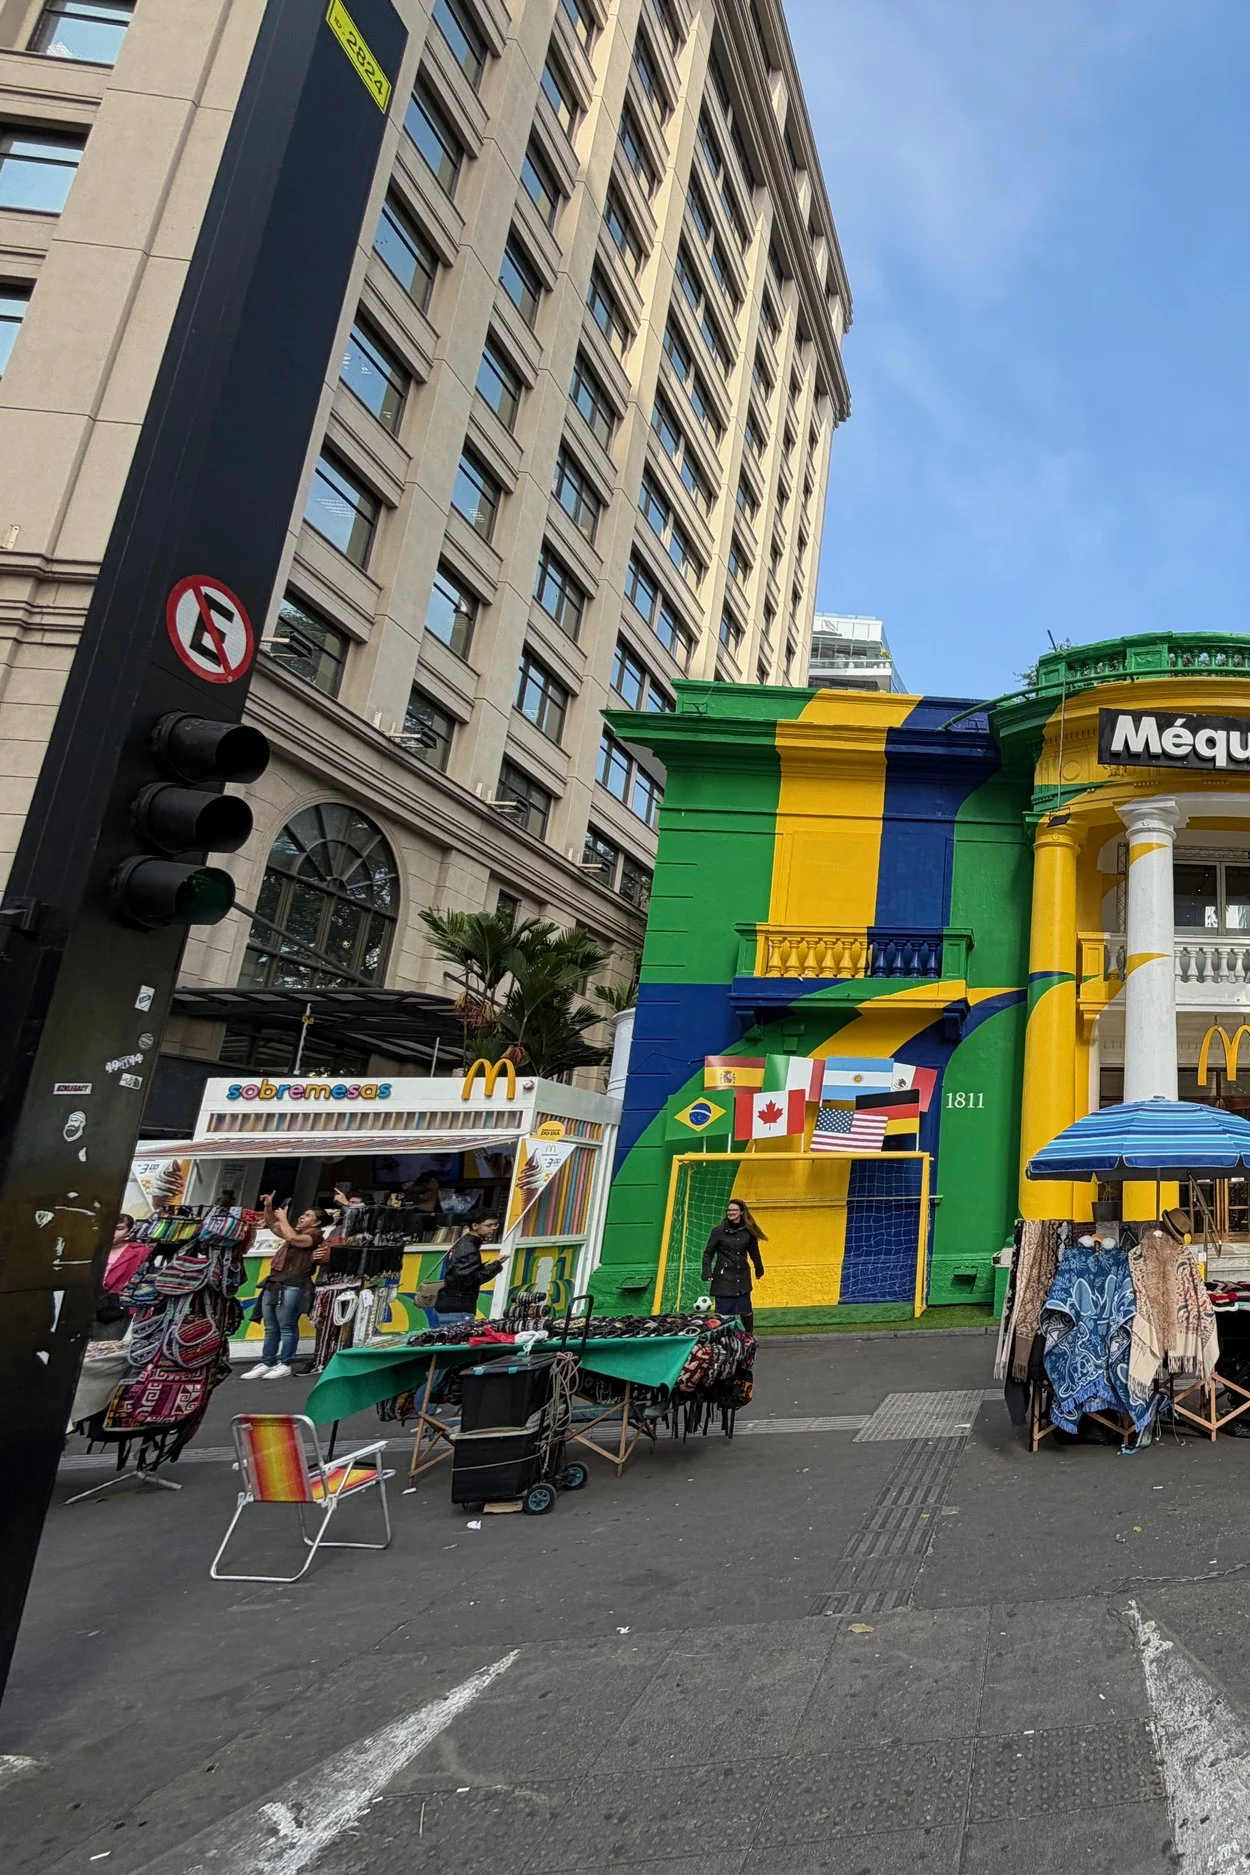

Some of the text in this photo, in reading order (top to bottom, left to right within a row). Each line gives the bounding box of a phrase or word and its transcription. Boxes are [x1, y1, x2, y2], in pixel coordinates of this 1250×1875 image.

[346, 31, 383, 95] 2824
[227, 1078, 393, 1101] sobremesas
[945, 1091, 985, 1109] 1811
